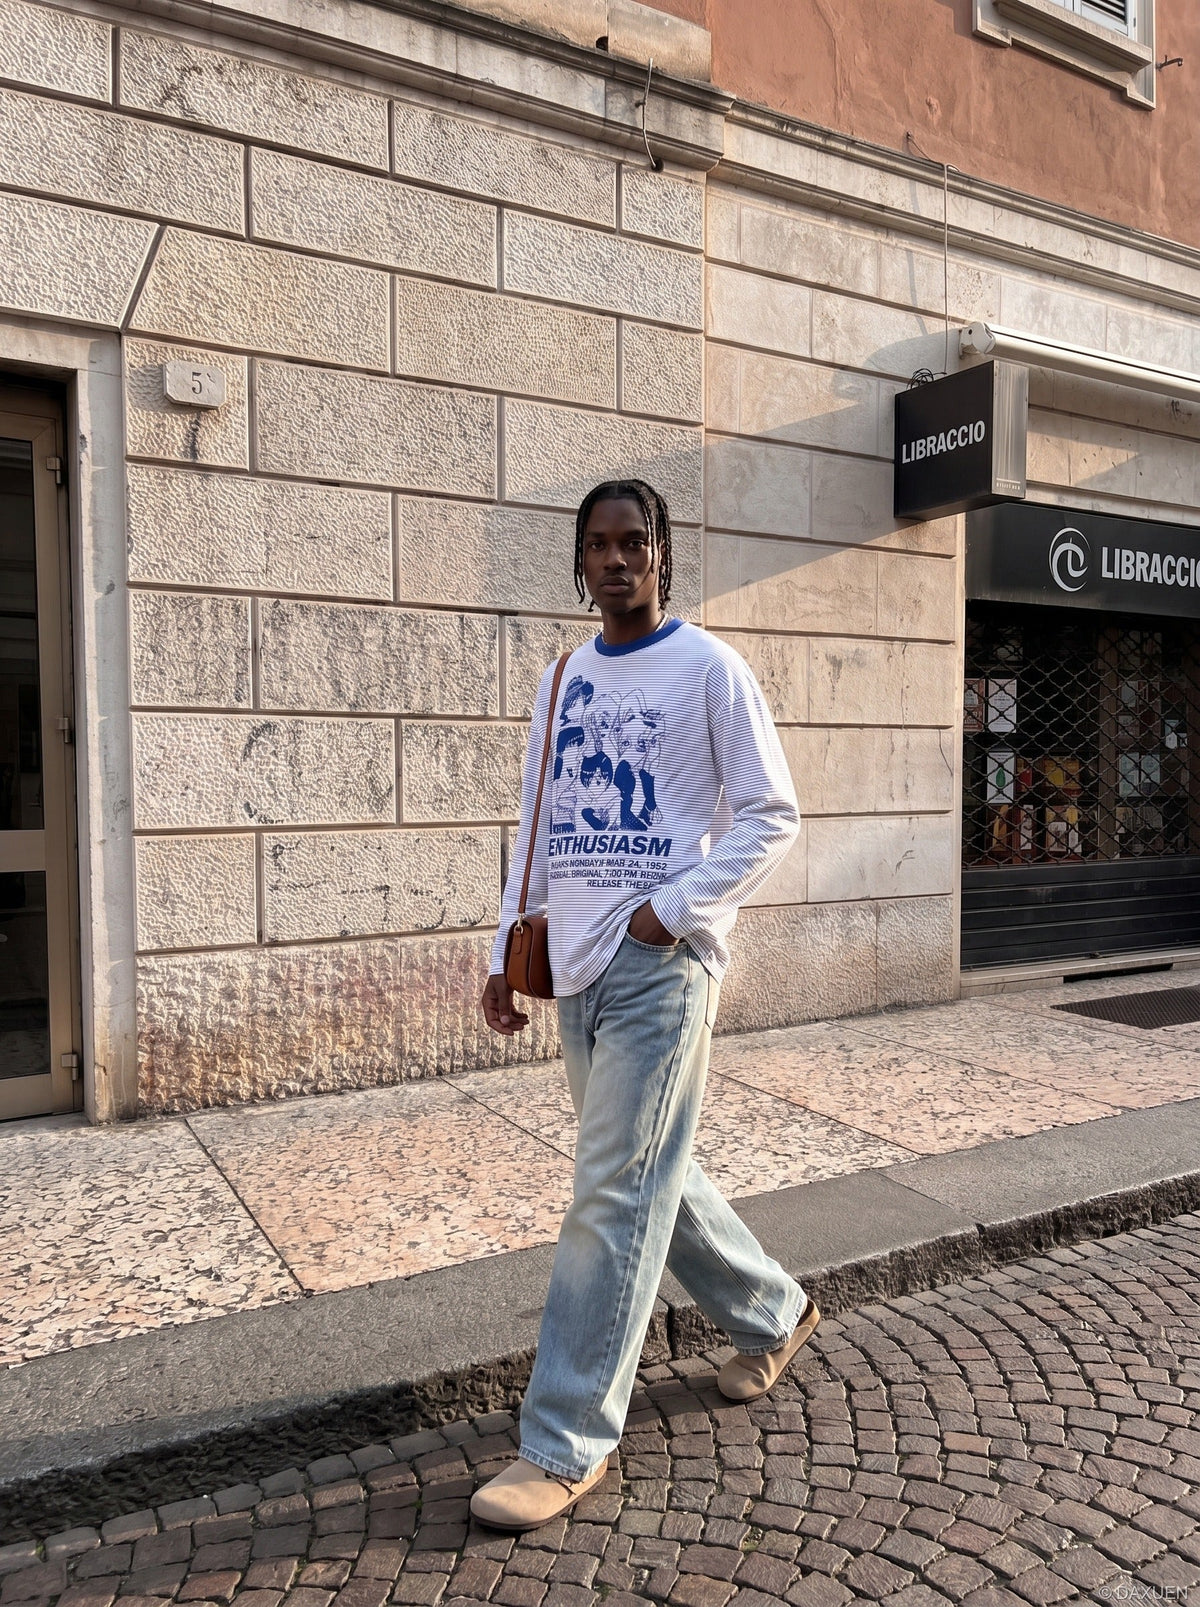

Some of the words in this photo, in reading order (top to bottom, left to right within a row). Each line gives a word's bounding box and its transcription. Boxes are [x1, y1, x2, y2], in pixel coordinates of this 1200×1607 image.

[901, 420, 985, 464] LIBRACCIO
[548, 834, 673, 857] ENTHUSIASM
[646, 861, 668, 871] 1952
[624, 869, 638, 879] PM
[586, 880, 622, 888] RELEASE
